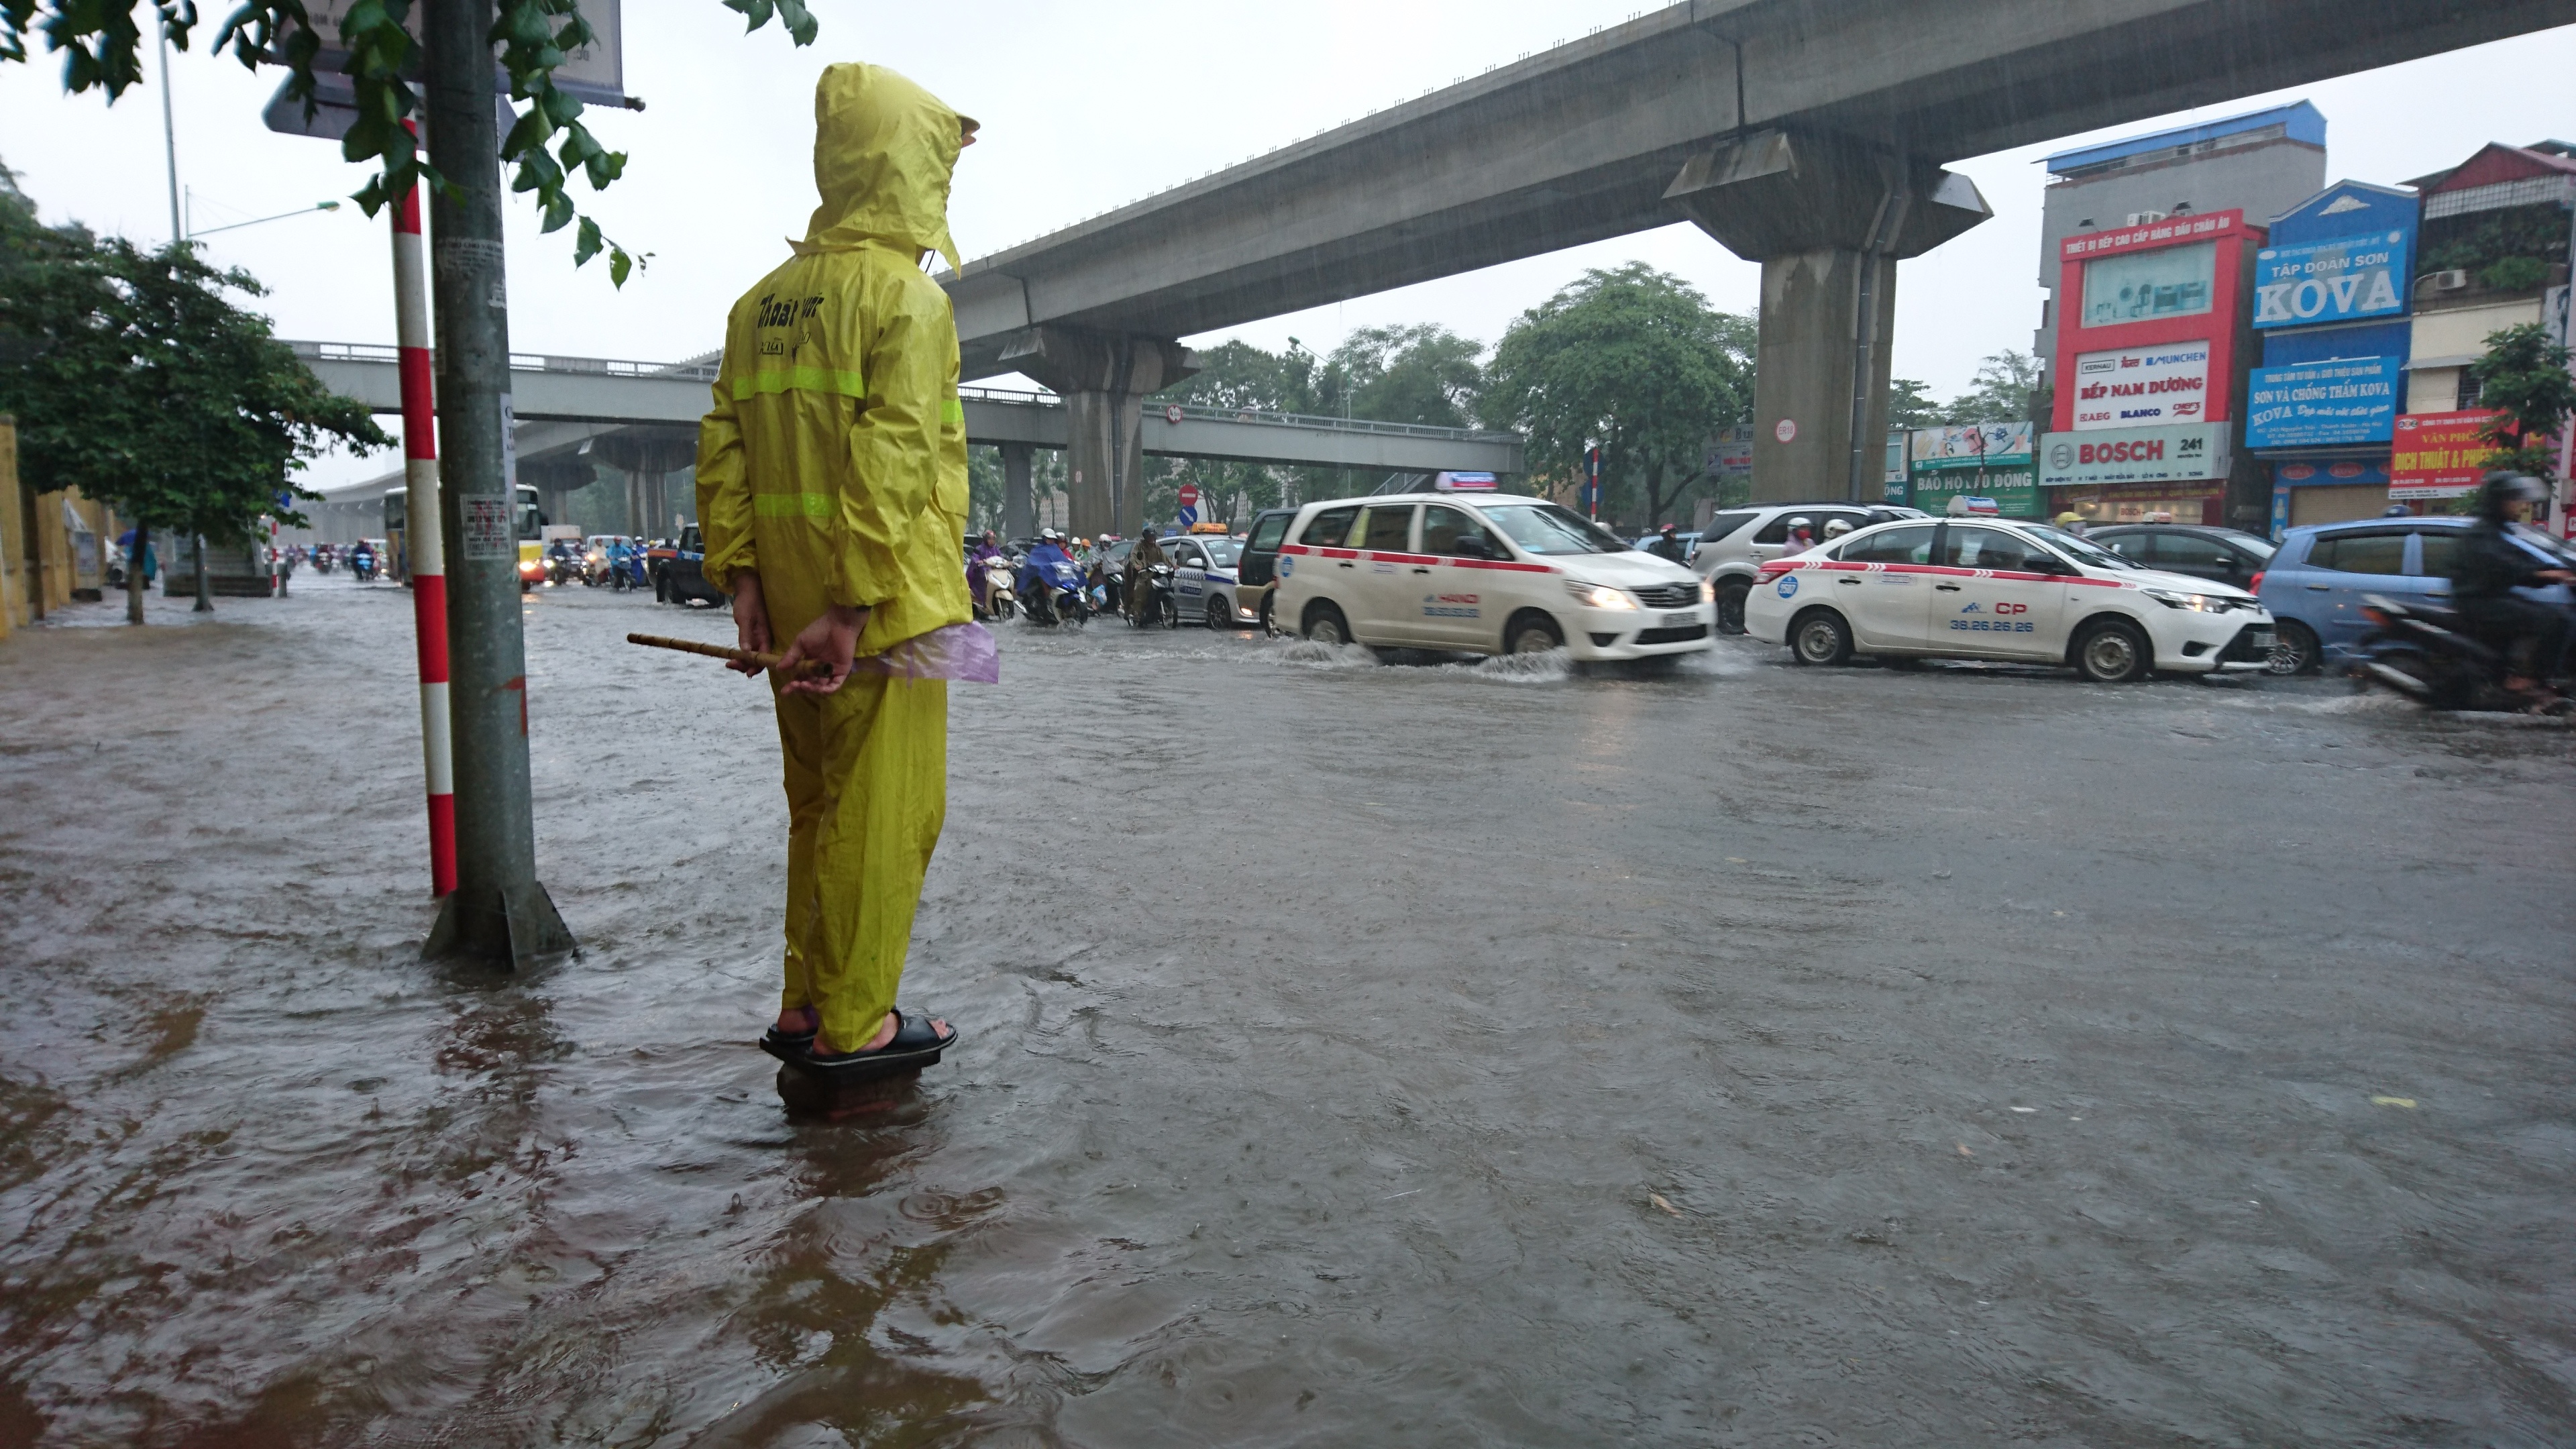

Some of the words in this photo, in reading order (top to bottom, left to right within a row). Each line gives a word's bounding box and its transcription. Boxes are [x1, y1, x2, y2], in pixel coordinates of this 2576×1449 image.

[2067, 241, 2085, 254] THIẾT
[2098, 235, 2113, 249] BẾP
[2116, 235, 2130, 246] CAO
[2133, 229, 2148, 243] CẤP
[2151, 226, 2171, 239] HÀNG
[2272, 263, 2301, 279] TẬP
[2305, 256, 2350, 273] ĐOÀN
[2355, 252, 2389, 266] SƠN
[2255, 270, 2400, 322] KOVA
[2081, 382, 2108, 399] BẾP
[2111, 382, 2145, 396] NAM
[2149, 376, 2203, 394] DƯƠNG
[2254, 390, 2274, 404] SƠN
[2276, 386, 2289, 402] VÀ
[2292, 382, 2326, 401] CHỐNG
[2360, 382, 2390, 396] KOVA
[2089, 412, 2110, 421] AEG
[2121, 409, 2161, 419] BLANCO
[2253, 406, 2292, 426] KOVA
[1778, 425, 1794, 435] ER18
[2080, 440, 2163, 464] BOSCH
[2180, 438, 2202, 451] 241
[2395, 453, 2417, 474] DỊCH
[2420, 447, 2449, 473] THUẬT
[2451, 451, 2459, 468] &
[1917, 470, 1941, 491] BẢO
[1945, 472, 1963, 493] HỘ
[1994, 470, 2032, 491] ĐỘNG
[2121, 507, 2141, 516] BOSCH
[1995, 602, 2027, 615] CP
[1951, 620, 2033, 632] 38.26.26.26
